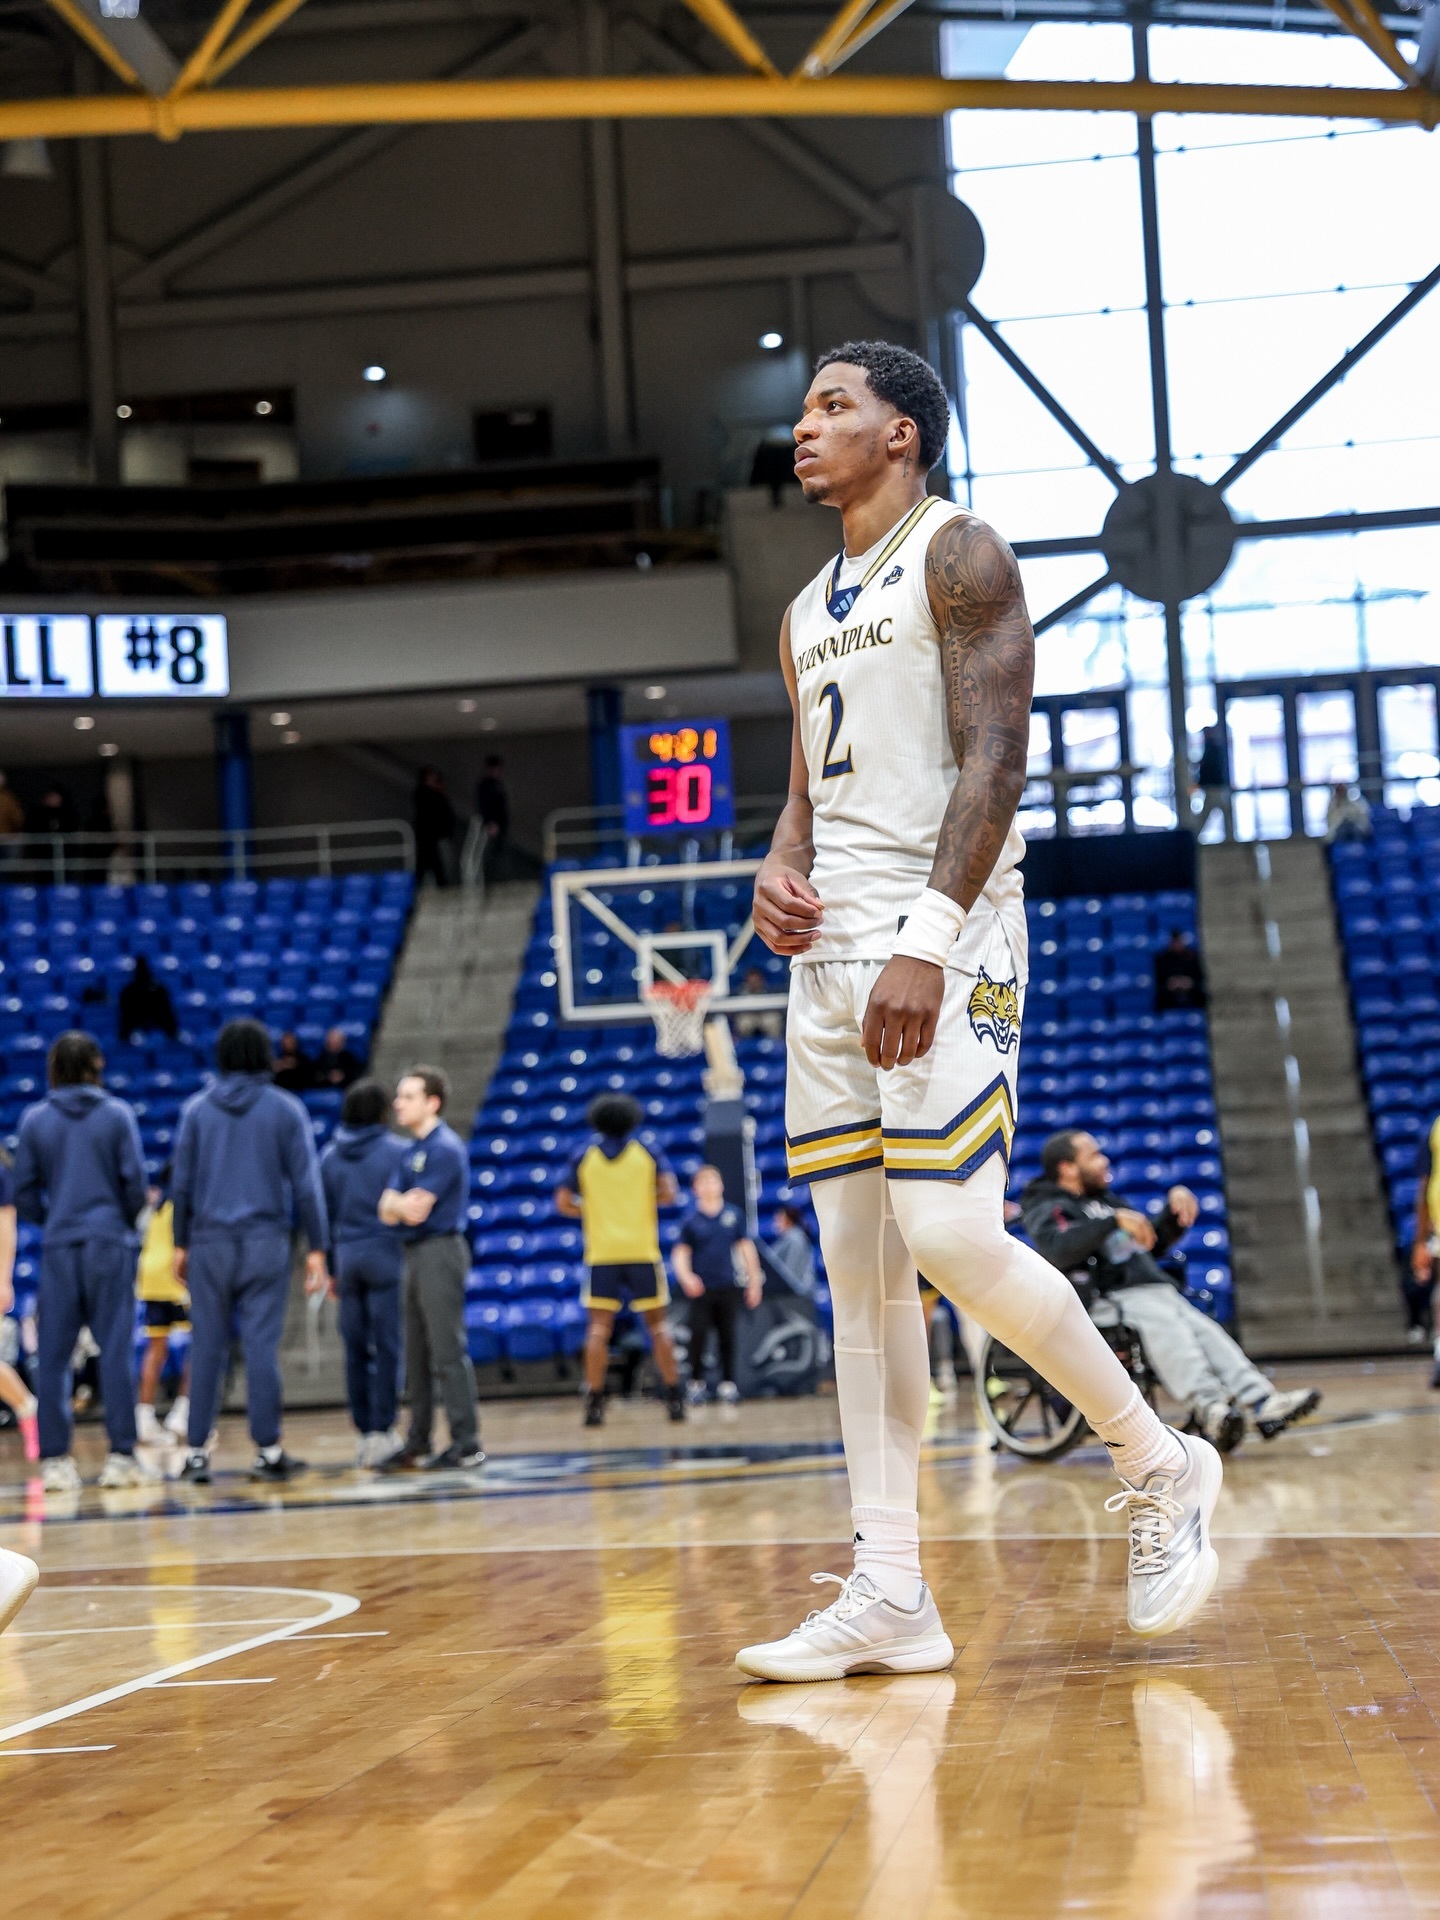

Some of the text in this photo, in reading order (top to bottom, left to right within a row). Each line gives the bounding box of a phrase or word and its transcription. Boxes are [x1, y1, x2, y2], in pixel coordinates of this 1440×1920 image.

[126, 625, 204, 685] #8
[818, 681, 855, 780] 2
[647, 764, 712, 825] 30
